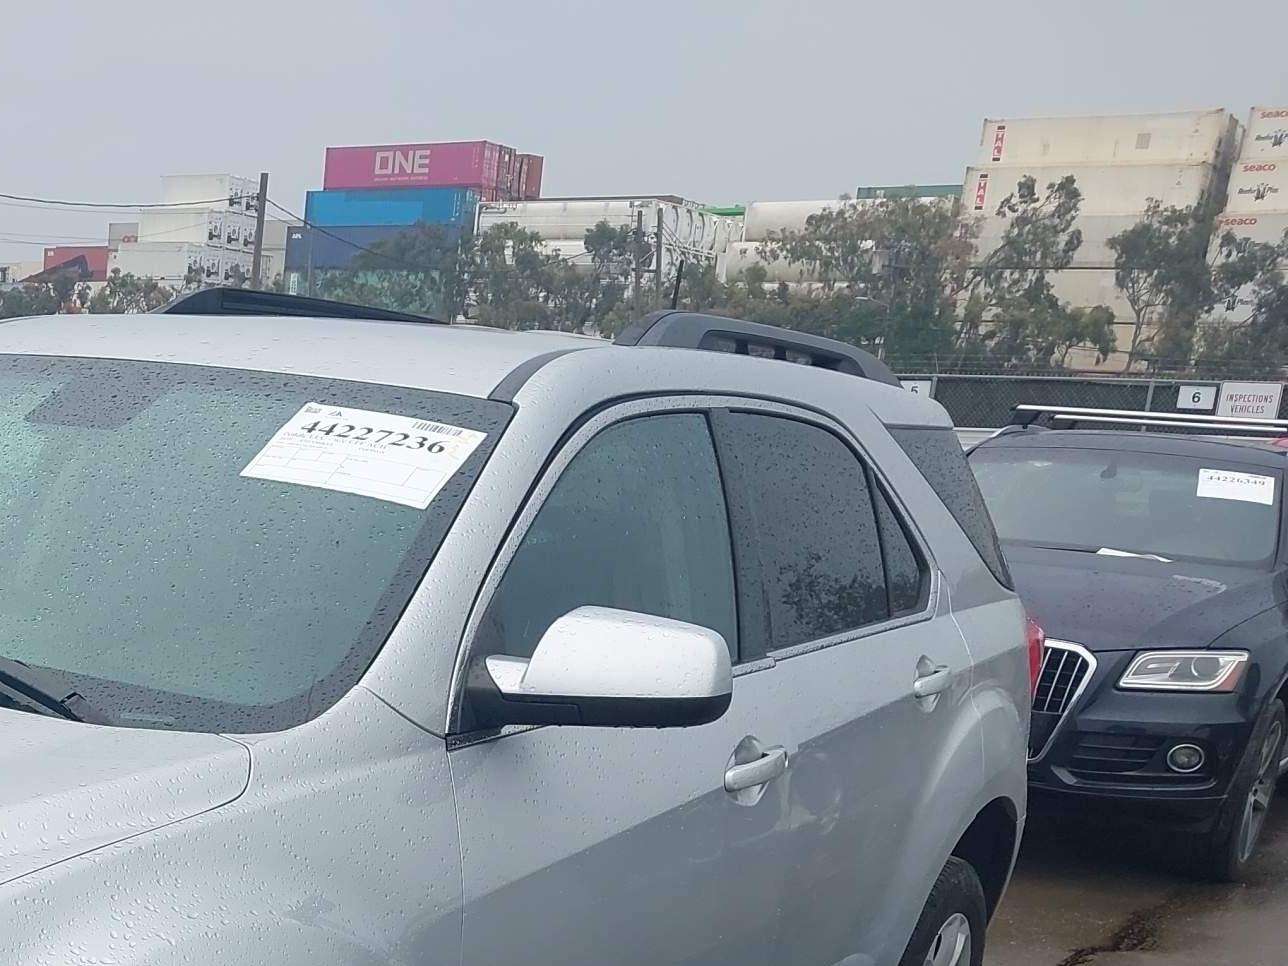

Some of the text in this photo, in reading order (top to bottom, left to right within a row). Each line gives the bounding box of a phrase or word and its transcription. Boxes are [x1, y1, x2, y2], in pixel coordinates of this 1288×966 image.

[1260, 110, 1288, 119] seac
[375, 150, 431, 174] ONE
[1242, 163, 1276, 172] seaco
[1223, 218, 1257, 226] seaco
[1192, 391, 1202, 404] 6
[1227, 393, 1274, 404] INSPECTIONS
[1230, 403, 1265, 414] VEHICLES
[300, 420, 447, 454] 44227236
